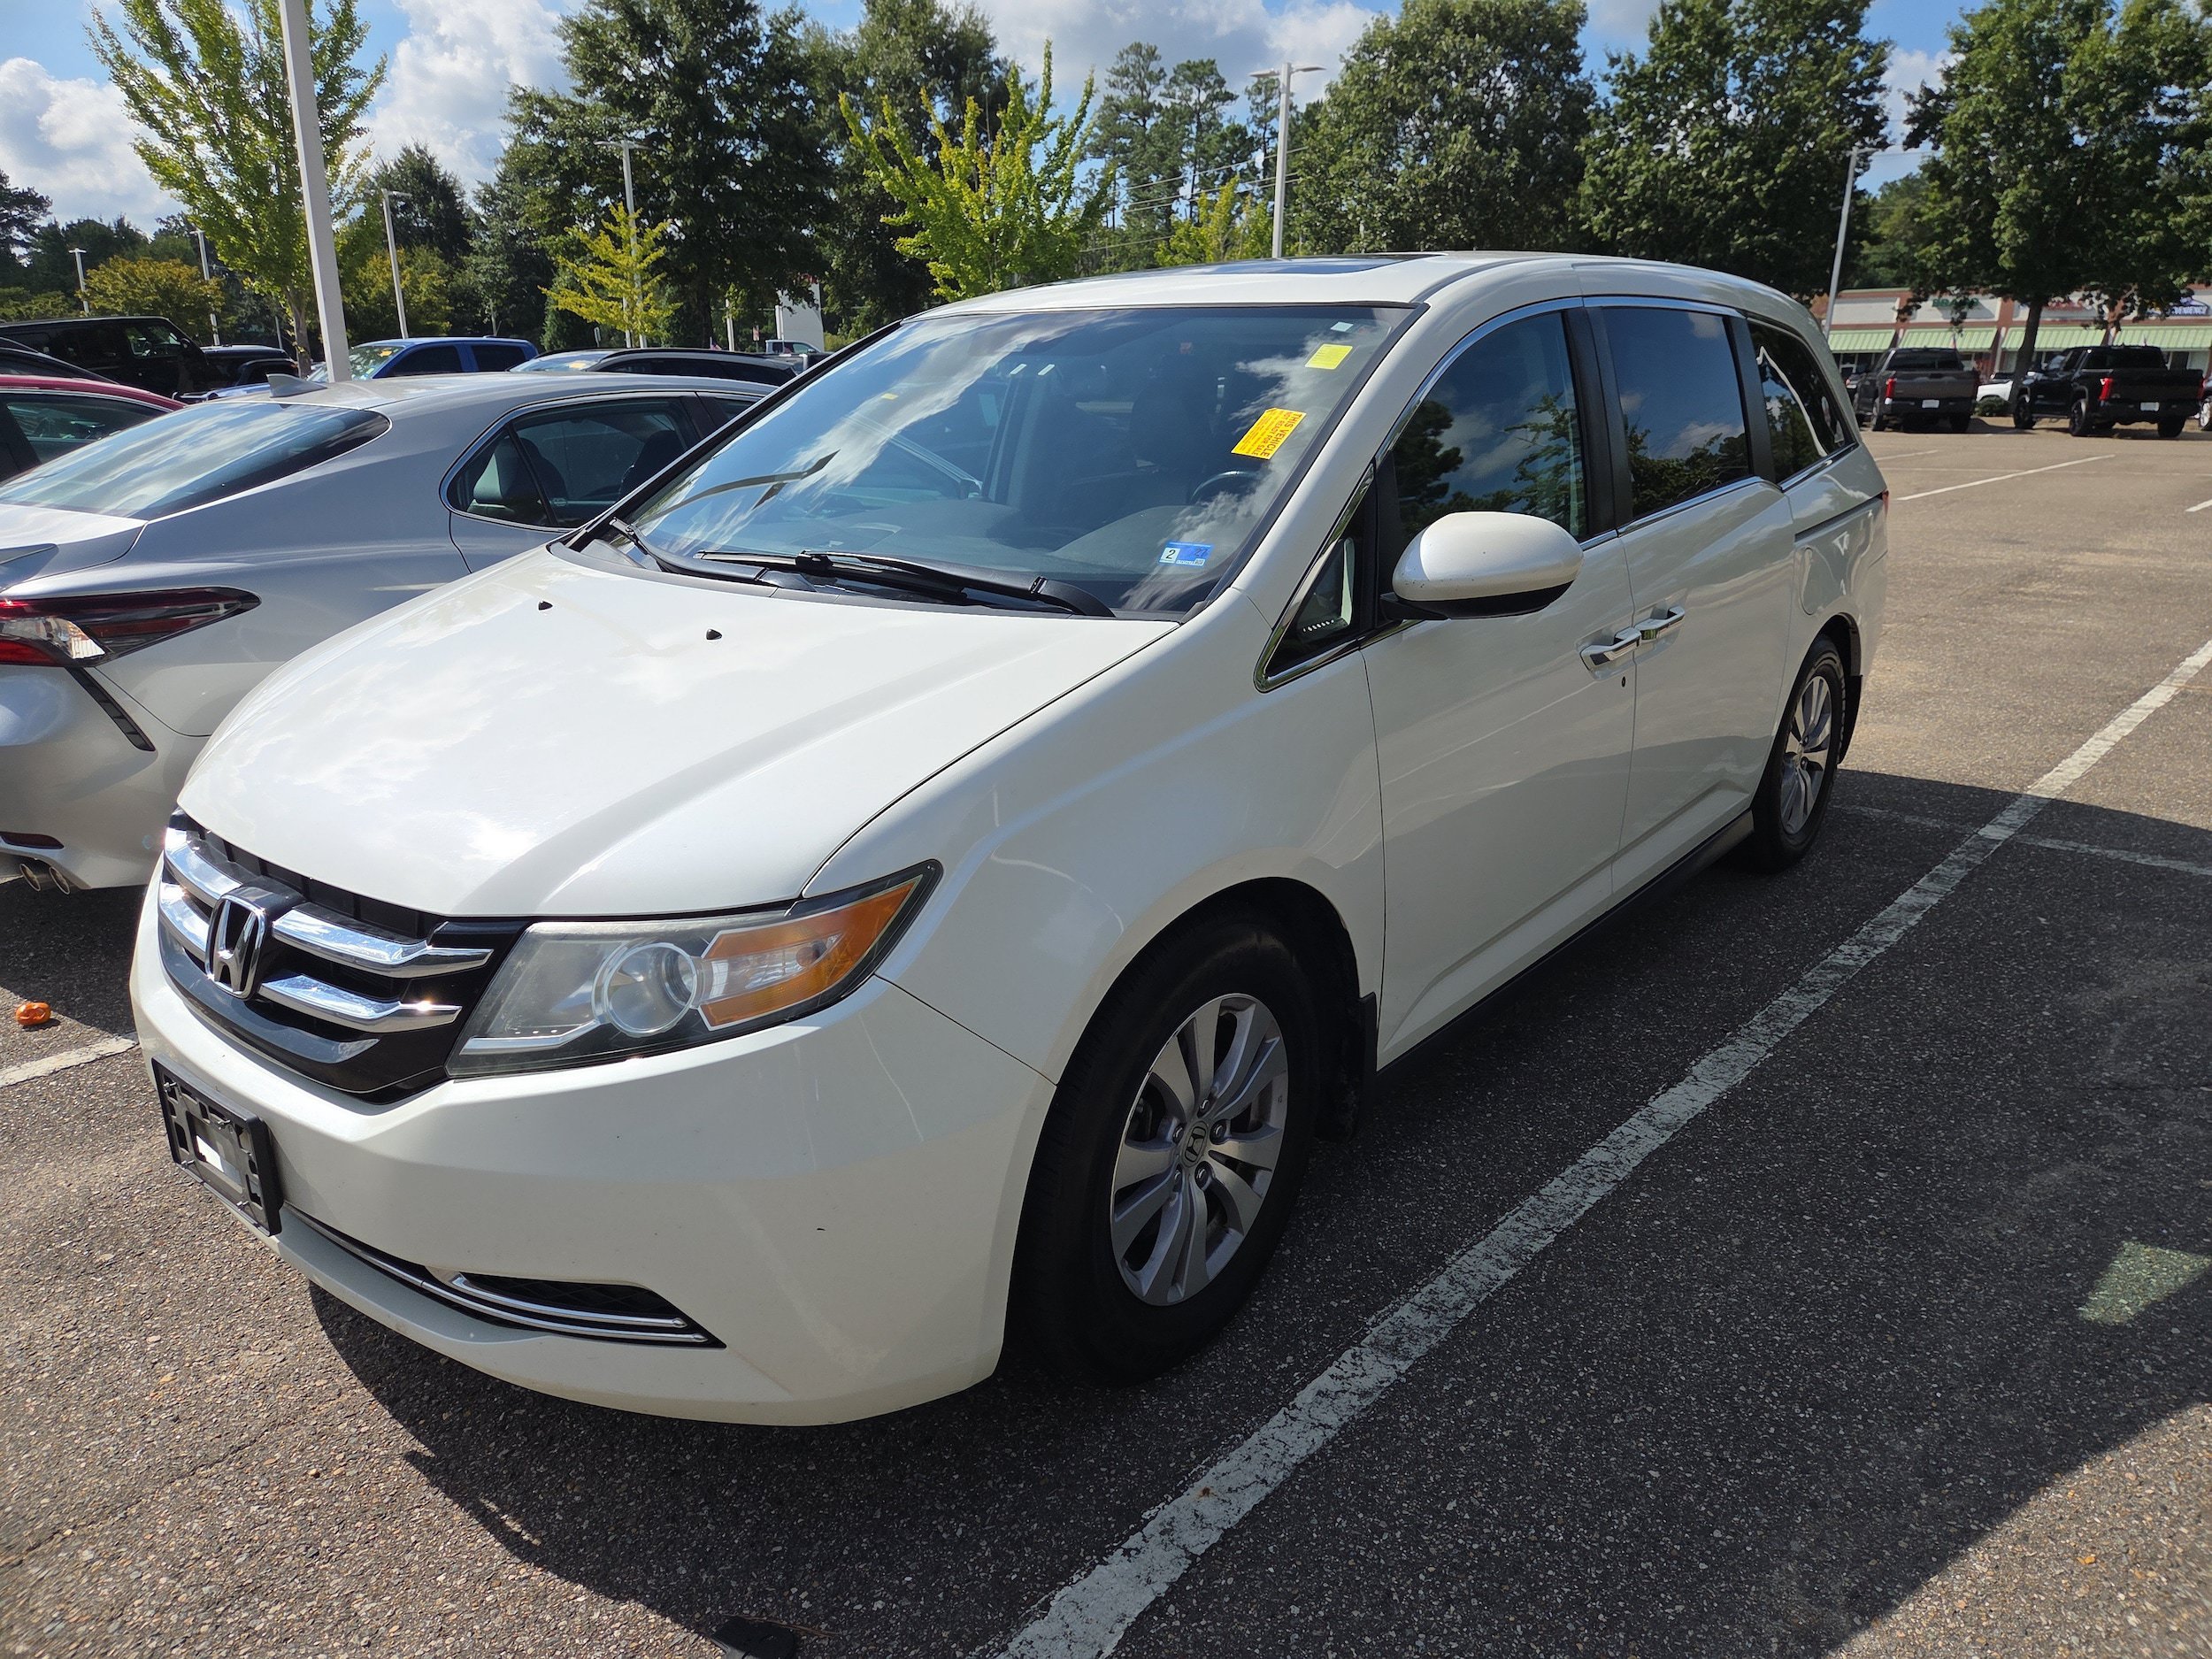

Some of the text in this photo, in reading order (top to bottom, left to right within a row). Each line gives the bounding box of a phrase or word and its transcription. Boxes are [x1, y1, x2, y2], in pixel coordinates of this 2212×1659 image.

[1260, 412, 1302, 457] THIS VEHICLE
[1165, 549, 1176, 559] 2
